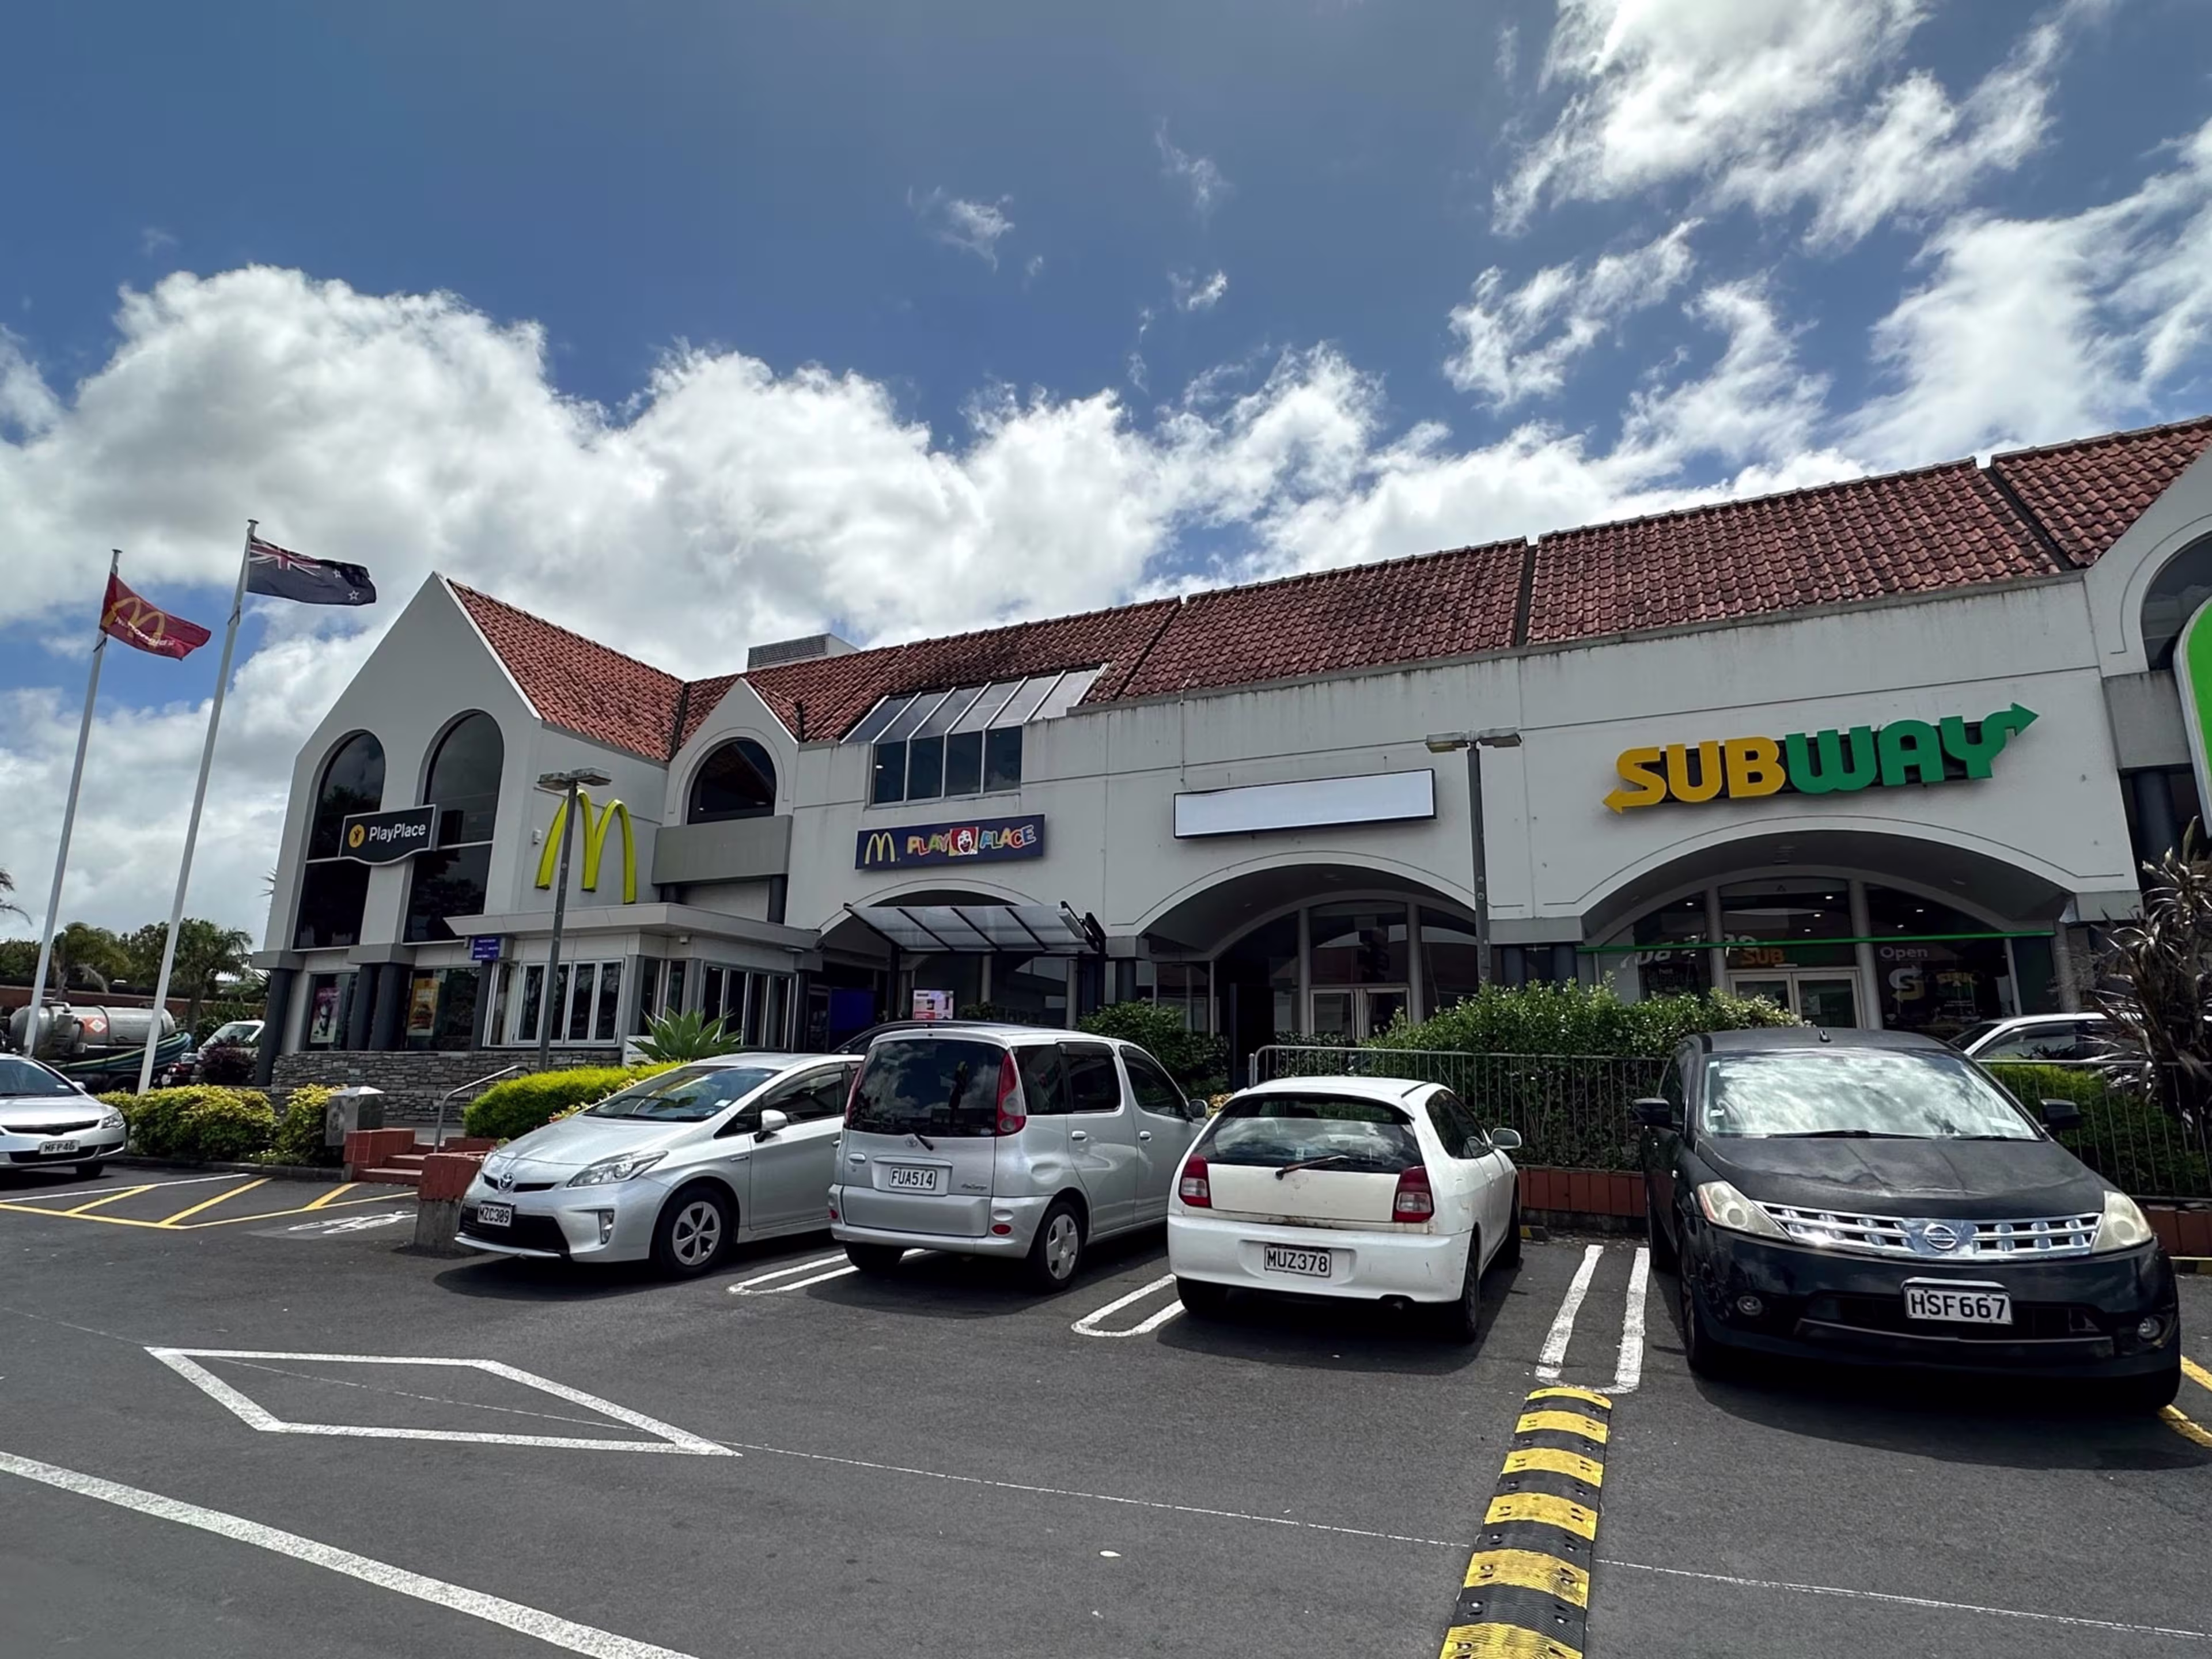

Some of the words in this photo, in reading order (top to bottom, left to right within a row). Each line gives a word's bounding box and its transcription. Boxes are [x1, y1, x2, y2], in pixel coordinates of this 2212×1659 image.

[1602, 702, 2039, 813] SUBWAY
[369, 823, 426, 843] PlayPlace
[907, 832, 950, 855] PLAY
[979, 824, 1036, 850] PLACE
[1880, 946, 1929, 961] Open
[891, 1170, 934, 1187] FUA514
[1267, 1249, 1328, 1272] MUZ378
[1910, 1293, 2006, 1320] HSF667
